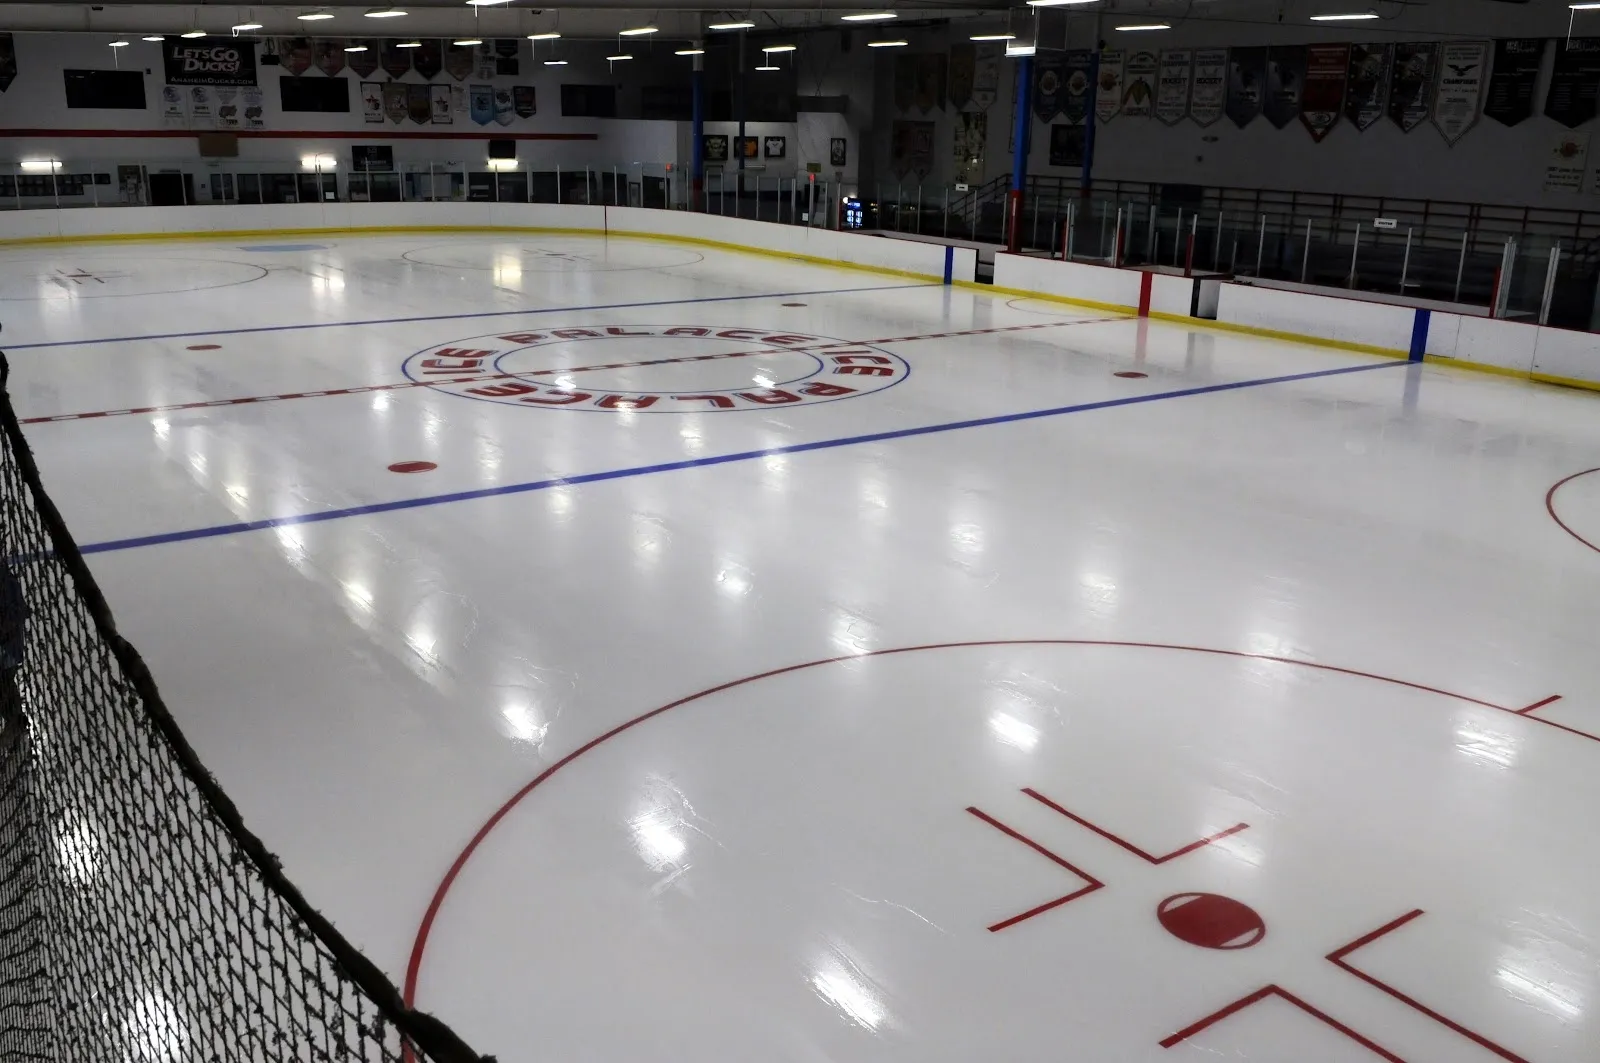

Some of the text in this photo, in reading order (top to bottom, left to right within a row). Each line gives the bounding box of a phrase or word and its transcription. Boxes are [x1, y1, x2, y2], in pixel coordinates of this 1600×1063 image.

[210, 46, 240, 62] GO
[184, 58, 241, 74] DUCKS!
[420, 327, 819, 375] ICE PALACE
[821, 350, 894, 377] ICE
